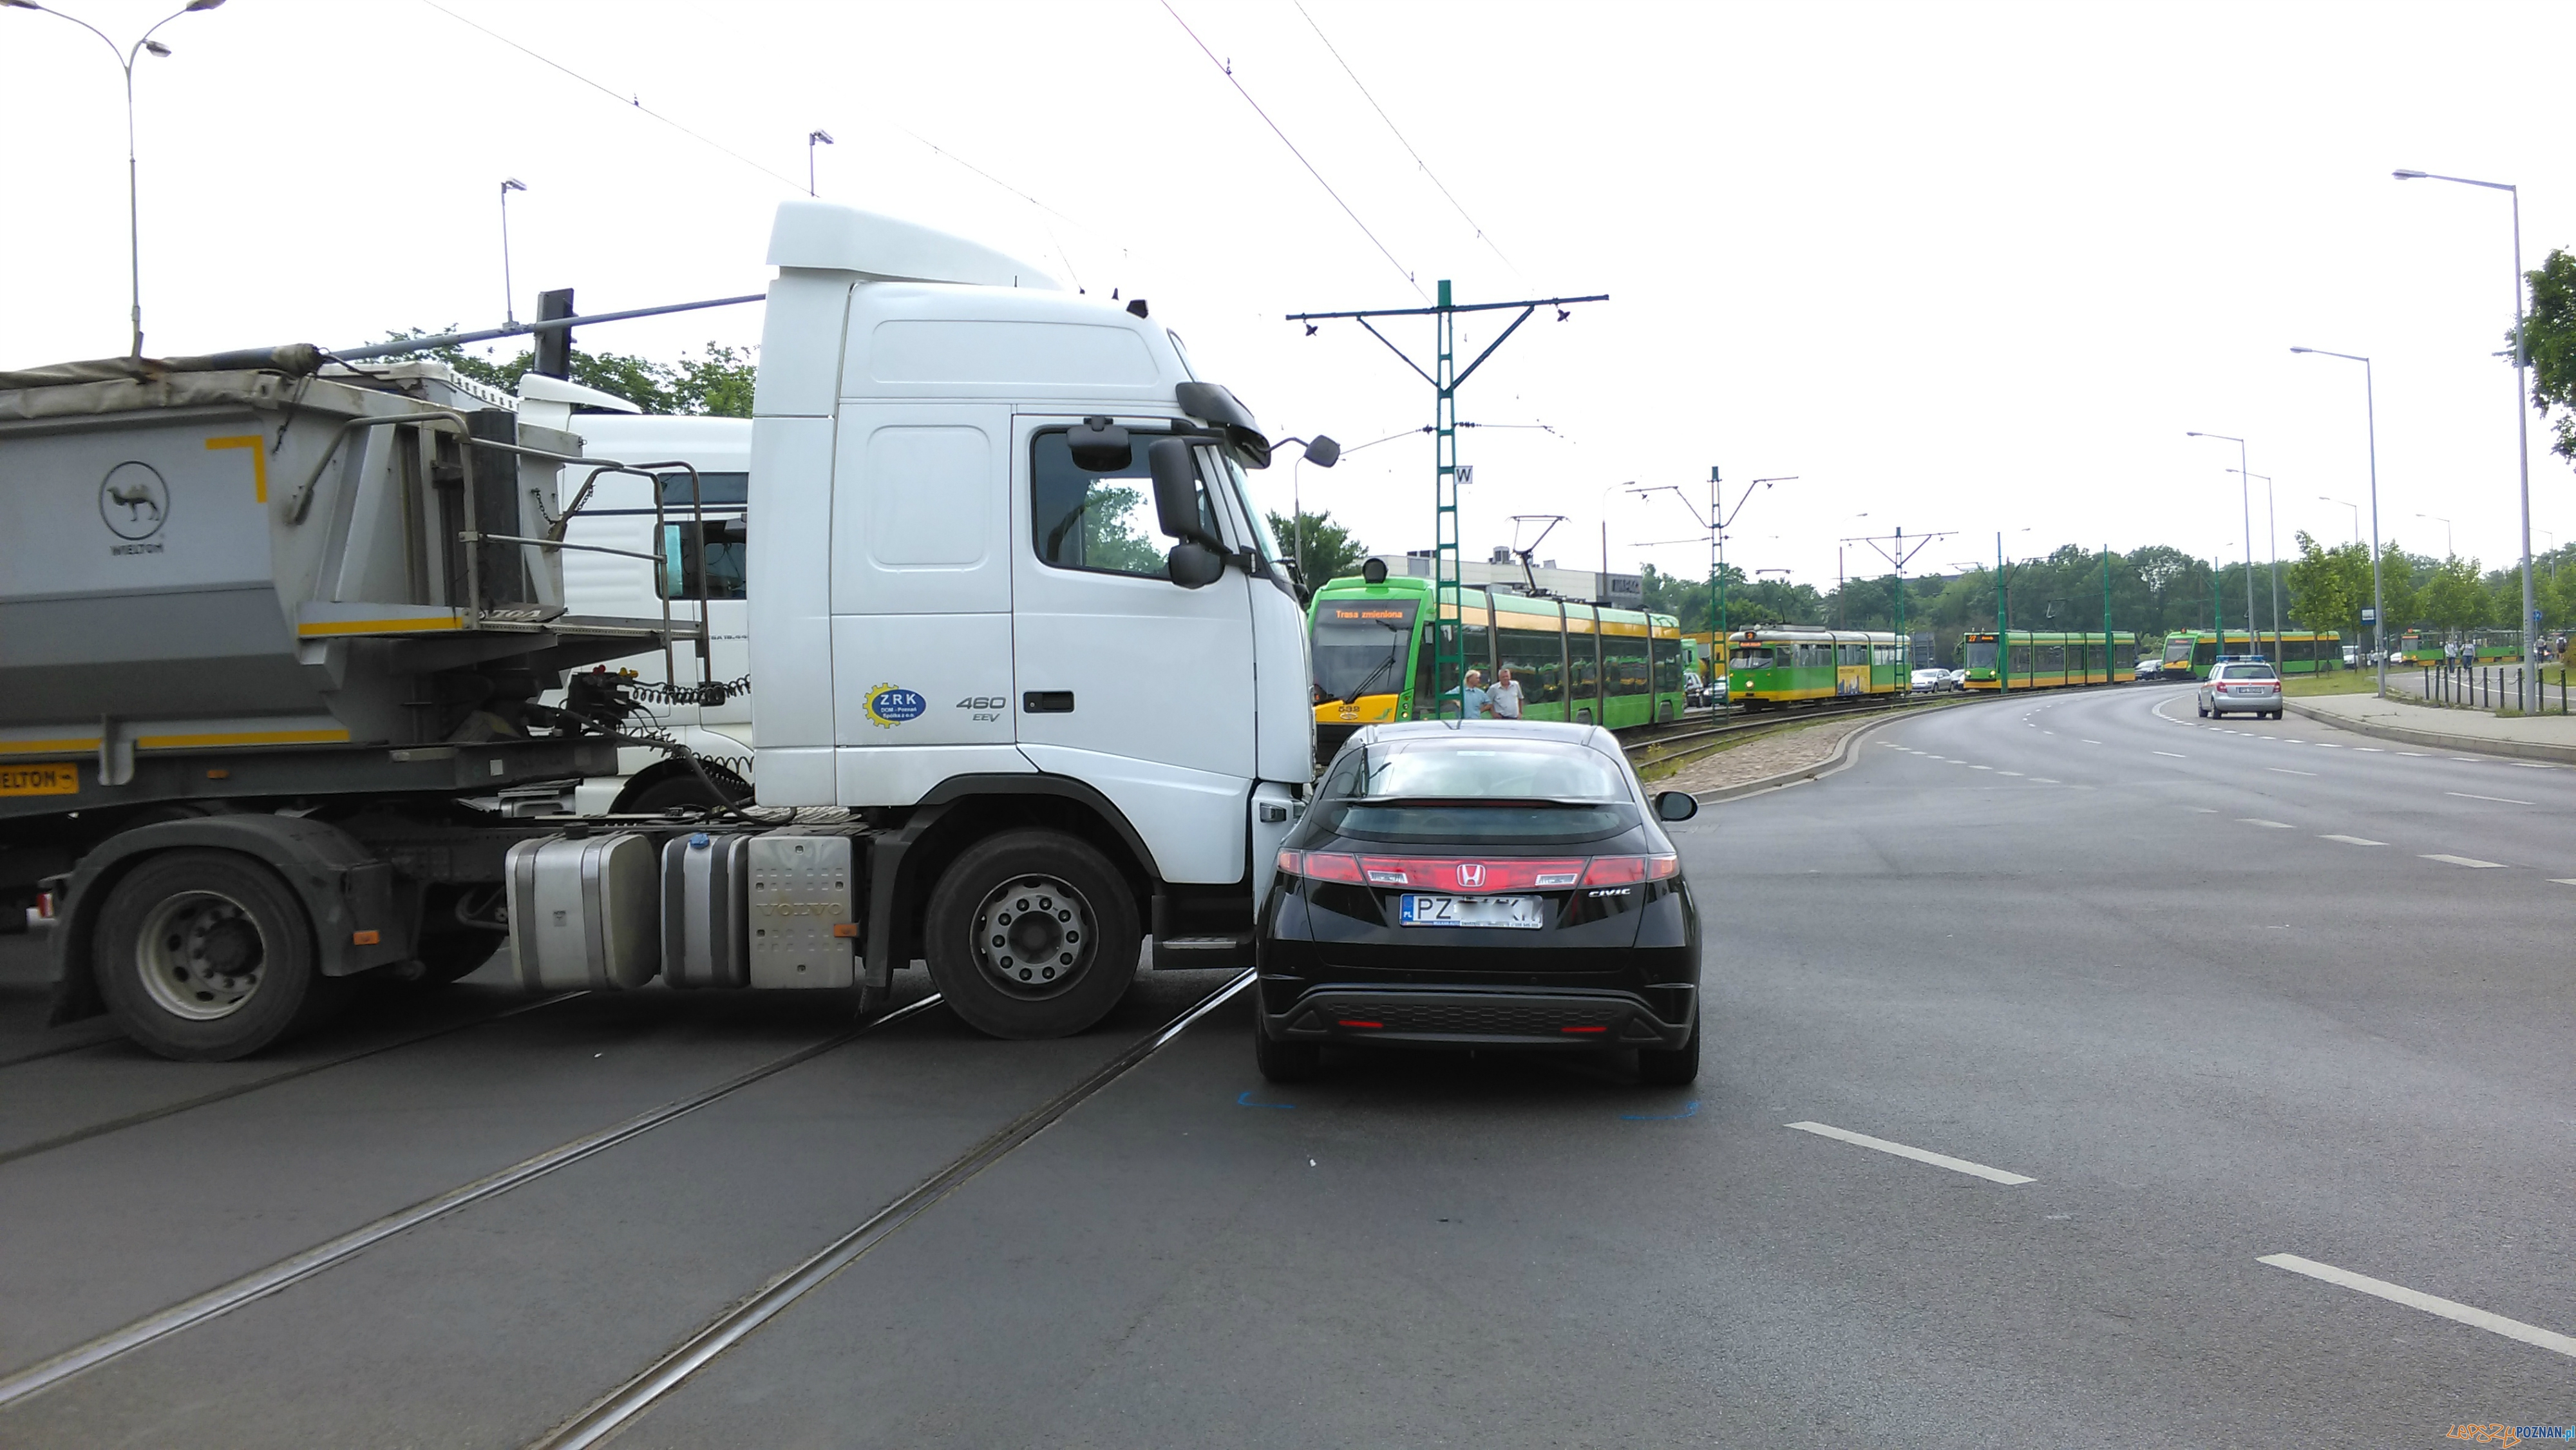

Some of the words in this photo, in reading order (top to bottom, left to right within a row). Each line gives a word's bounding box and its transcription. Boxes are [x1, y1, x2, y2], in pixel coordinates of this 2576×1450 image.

[1456, 468, 1472, 482] W
[109, 544, 164, 555] WIELTON
[1336, 610, 1359, 618] Trasa
[1361, 610, 1403, 618] zmieniona
[956, 696, 1007, 709] 460
[972, 713, 1000, 722] EEV
[1588, 888, 1631, 898] CIVIC
[756, 903, 844, 916] VOLVO
